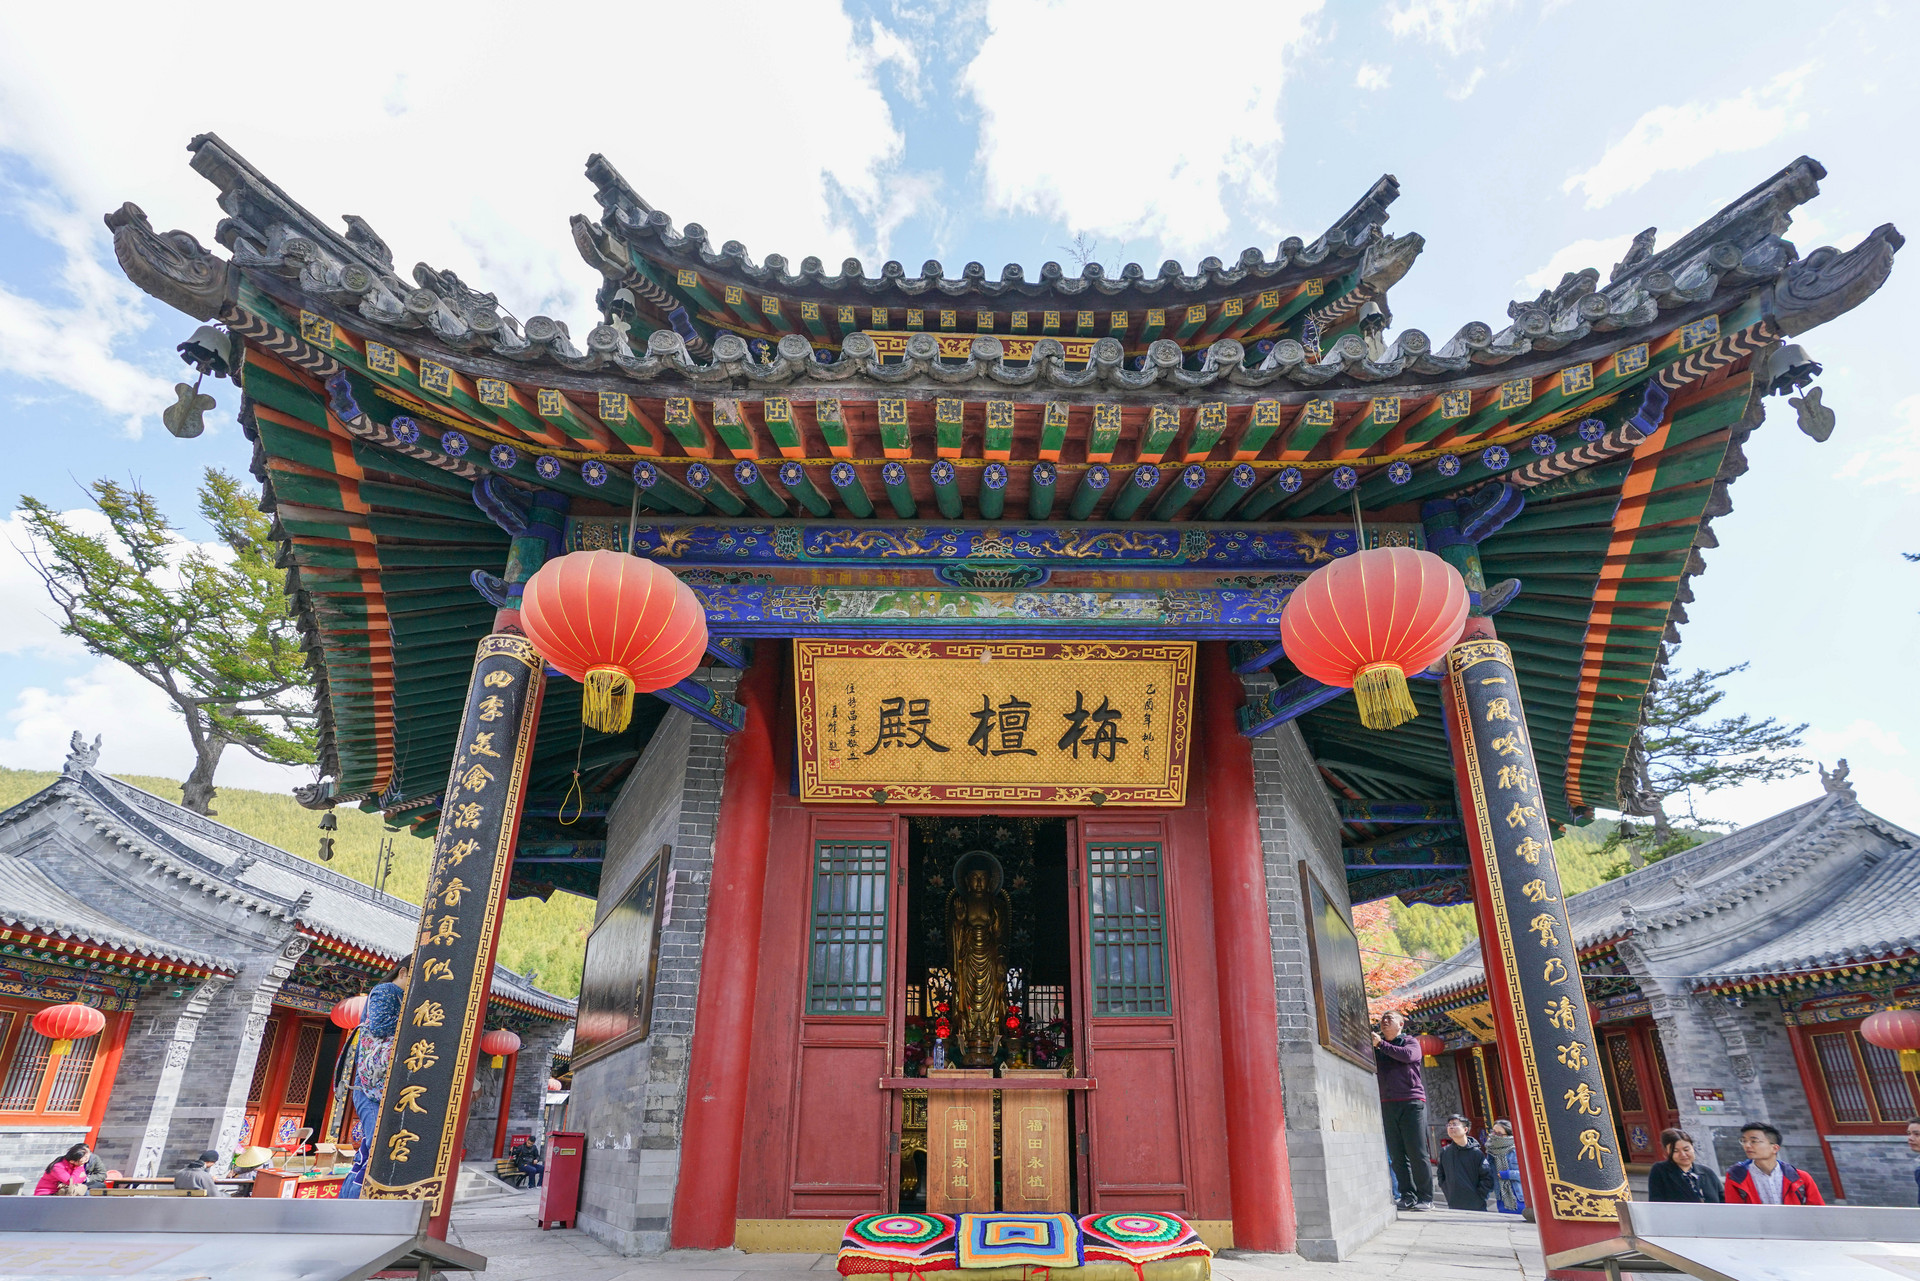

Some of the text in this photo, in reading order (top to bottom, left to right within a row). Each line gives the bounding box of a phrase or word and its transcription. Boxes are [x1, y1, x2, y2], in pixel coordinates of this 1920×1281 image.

[952, 1120, 968, 1187] 福田永植
[1027, 1120, 1044, 1187] 福田永植
